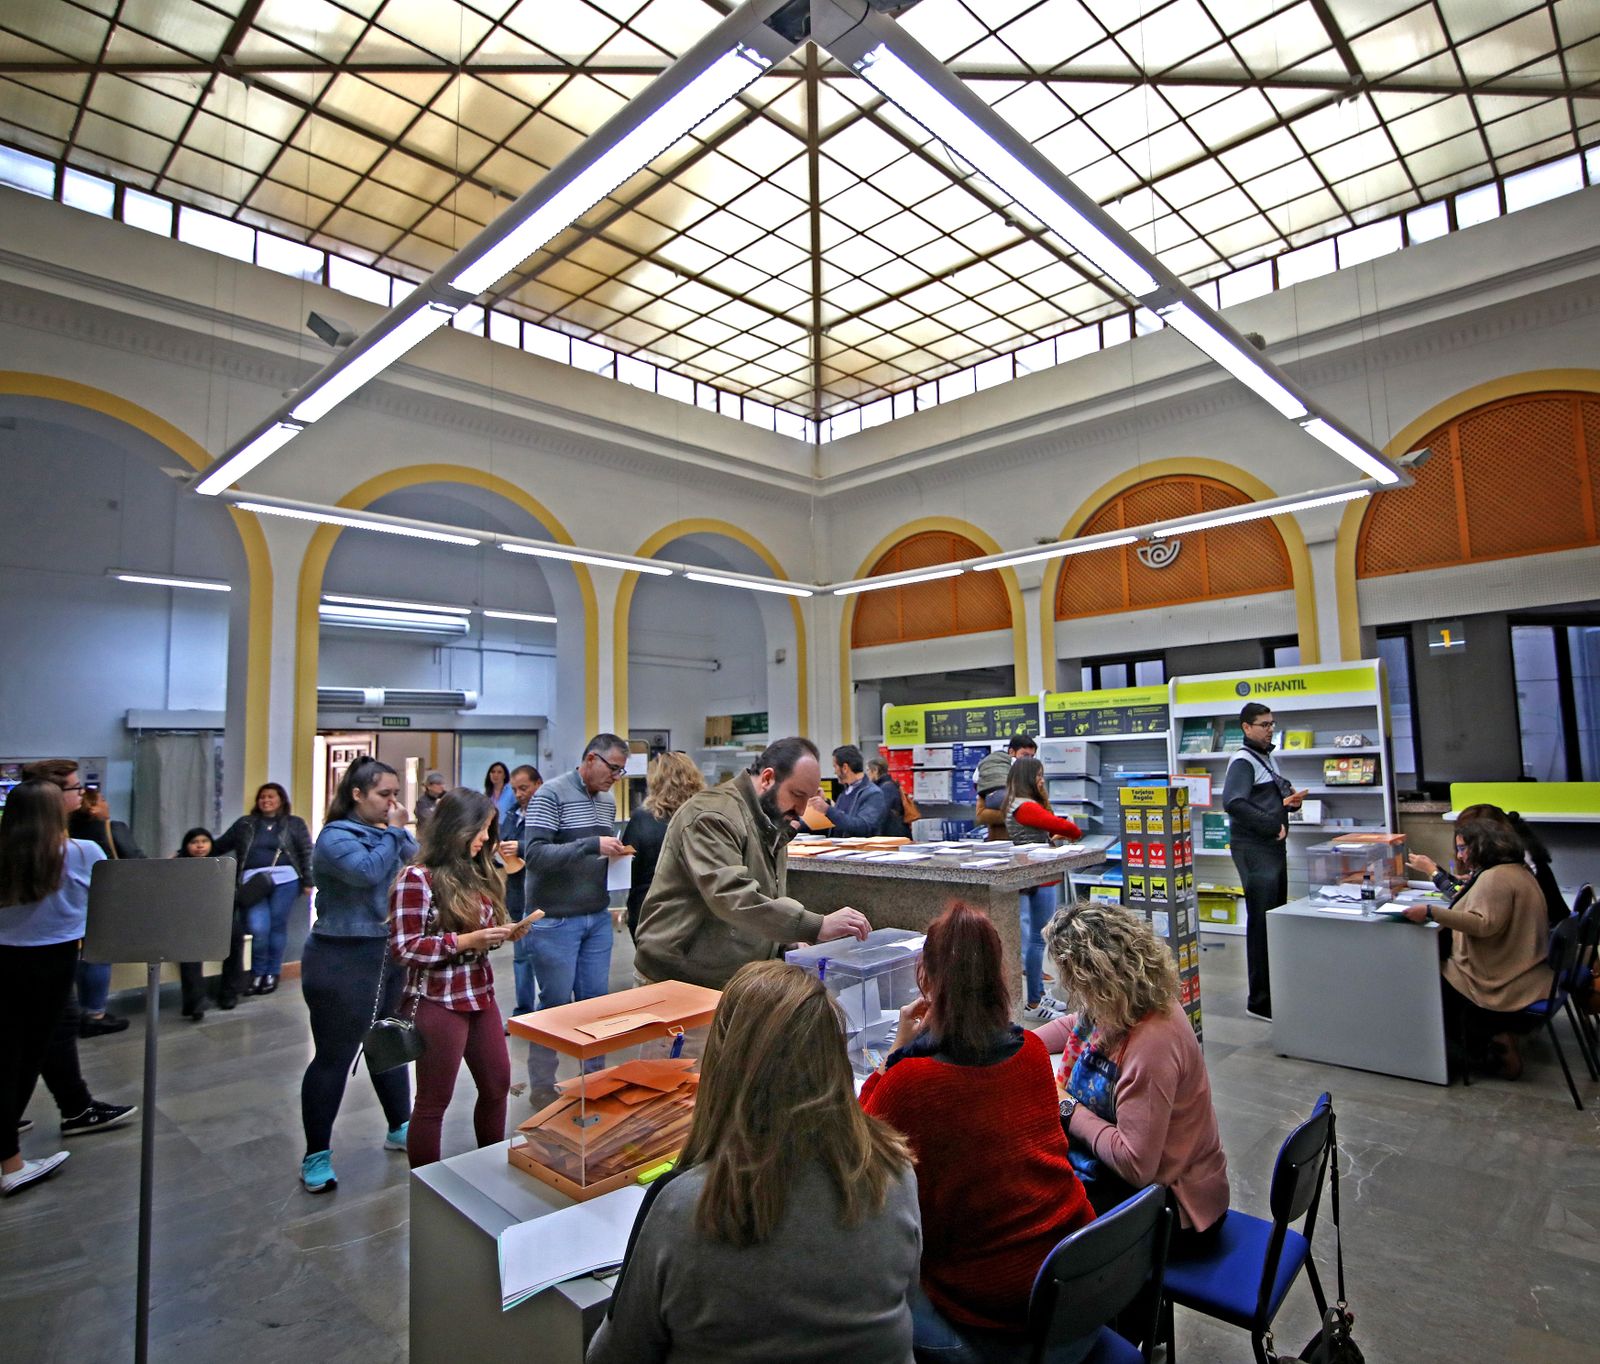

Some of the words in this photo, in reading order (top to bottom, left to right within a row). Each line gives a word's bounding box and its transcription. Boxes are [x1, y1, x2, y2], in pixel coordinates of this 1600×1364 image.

[1440, 629, 1450, 647] 1
[1254, 679, 1307, 693] INFANTIL
[966, 711, 973, 722] 2
[993, 709, 1000, 721] 3
